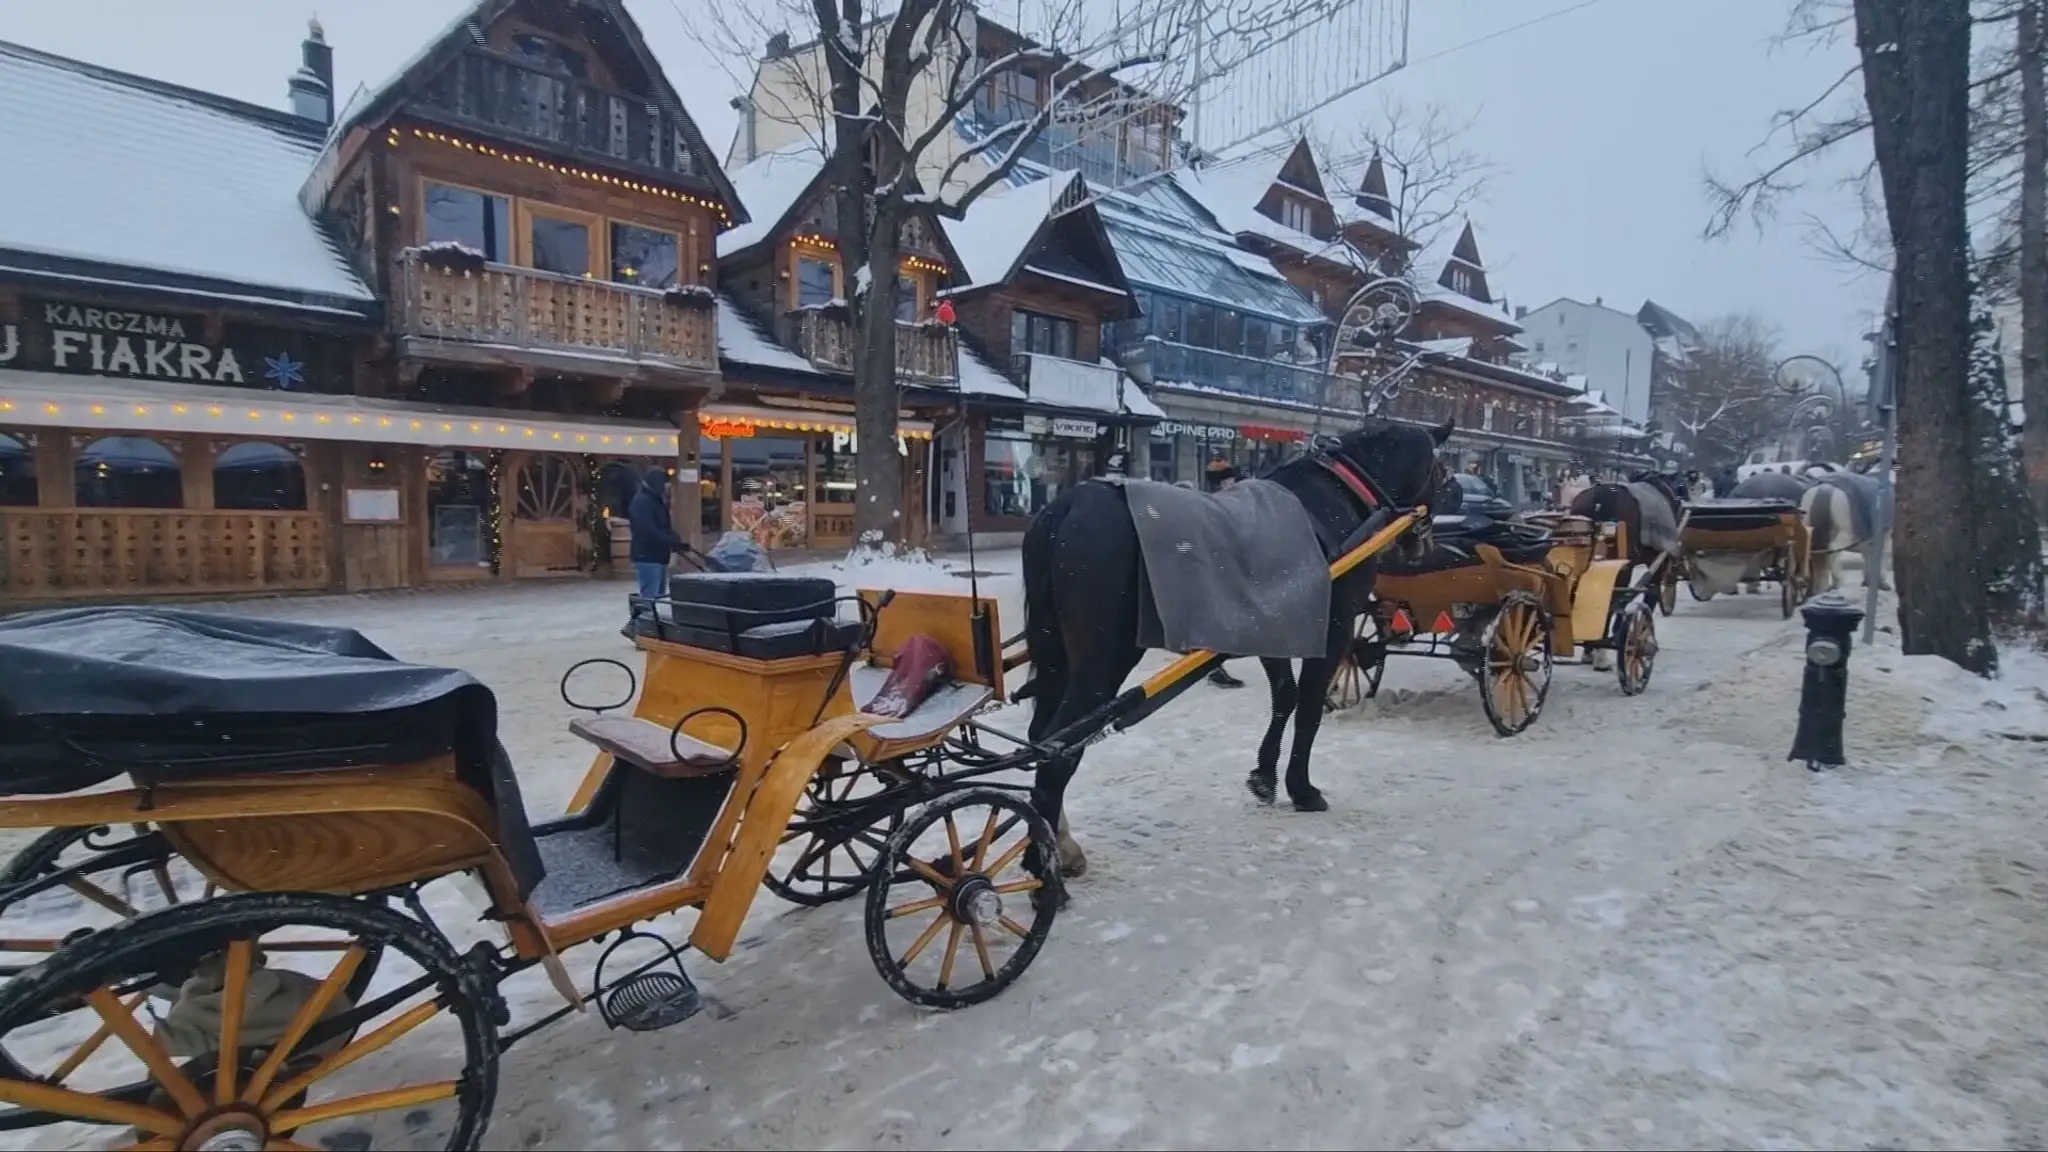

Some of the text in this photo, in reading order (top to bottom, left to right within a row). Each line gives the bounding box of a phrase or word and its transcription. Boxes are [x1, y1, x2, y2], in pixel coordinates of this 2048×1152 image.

[45, 303, 186, 338] KARCZMA
[52, 329, 245, 383] FIAKRA
[1150, 420, 1206, 437] ALPINE
[1207, 427, 1235, 440] PRO
